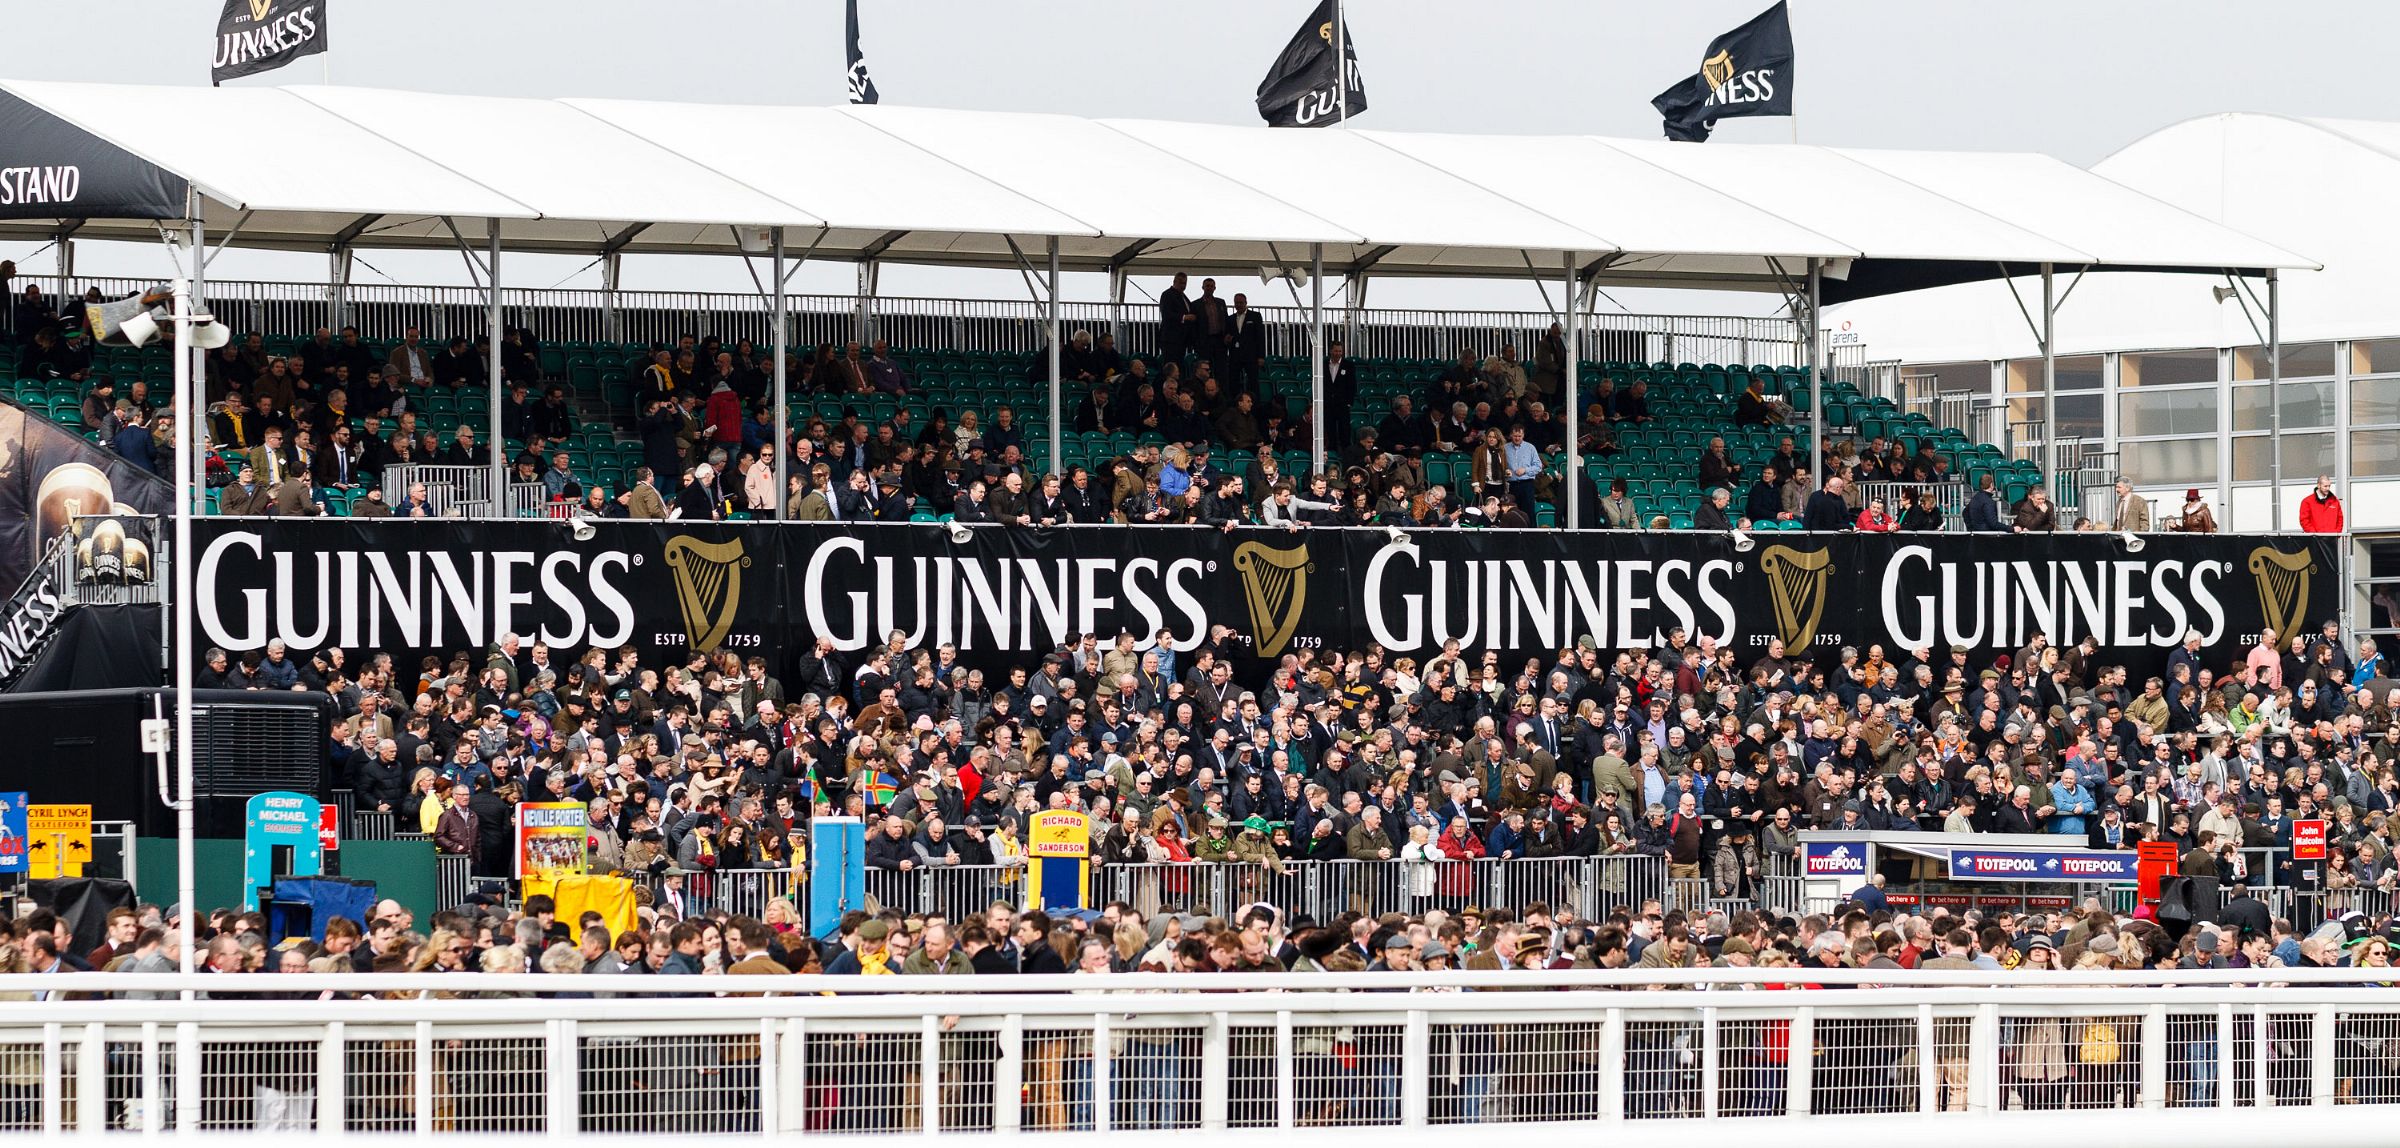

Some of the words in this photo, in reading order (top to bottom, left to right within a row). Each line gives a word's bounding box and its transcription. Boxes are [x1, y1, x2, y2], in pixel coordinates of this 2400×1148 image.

[213, 5, 316, 68] UINNESS
[0, 165, 80, 205] STAND
[1832, 332, 1859, 344] arena
[728, 634, 761, 646] 1759
[1294, 636, 1322, 648] 1759
[1815, 634, 1841, 645] 1759
[2240, 634, 2262, 645] EST
[265, 797, 304, 808] HENRY
[27, 808, 55, 818] CYRIL
[58, 808, 88, 818] LYNCH
[259, 811, 309, 822] MICHAEL
[524, 809, 554, 827] NEVILLE
[555, 808, 585, 827] PORTER
[1042, 816, 1082, 827] RICHARD
[2301, 827, 2319, 835] John
[0, 837, 24, 854] OX
[2296, 837, 2324, 846] Malcolm
[1038, 843, 1085, 852] SANDERSON
[1809, 858, 1863, 870] TOTEPOOL
[1976, 858, 2037, 872] TOTEPOOL
[2063, 859, 2124, 873] TOTEPOOL
